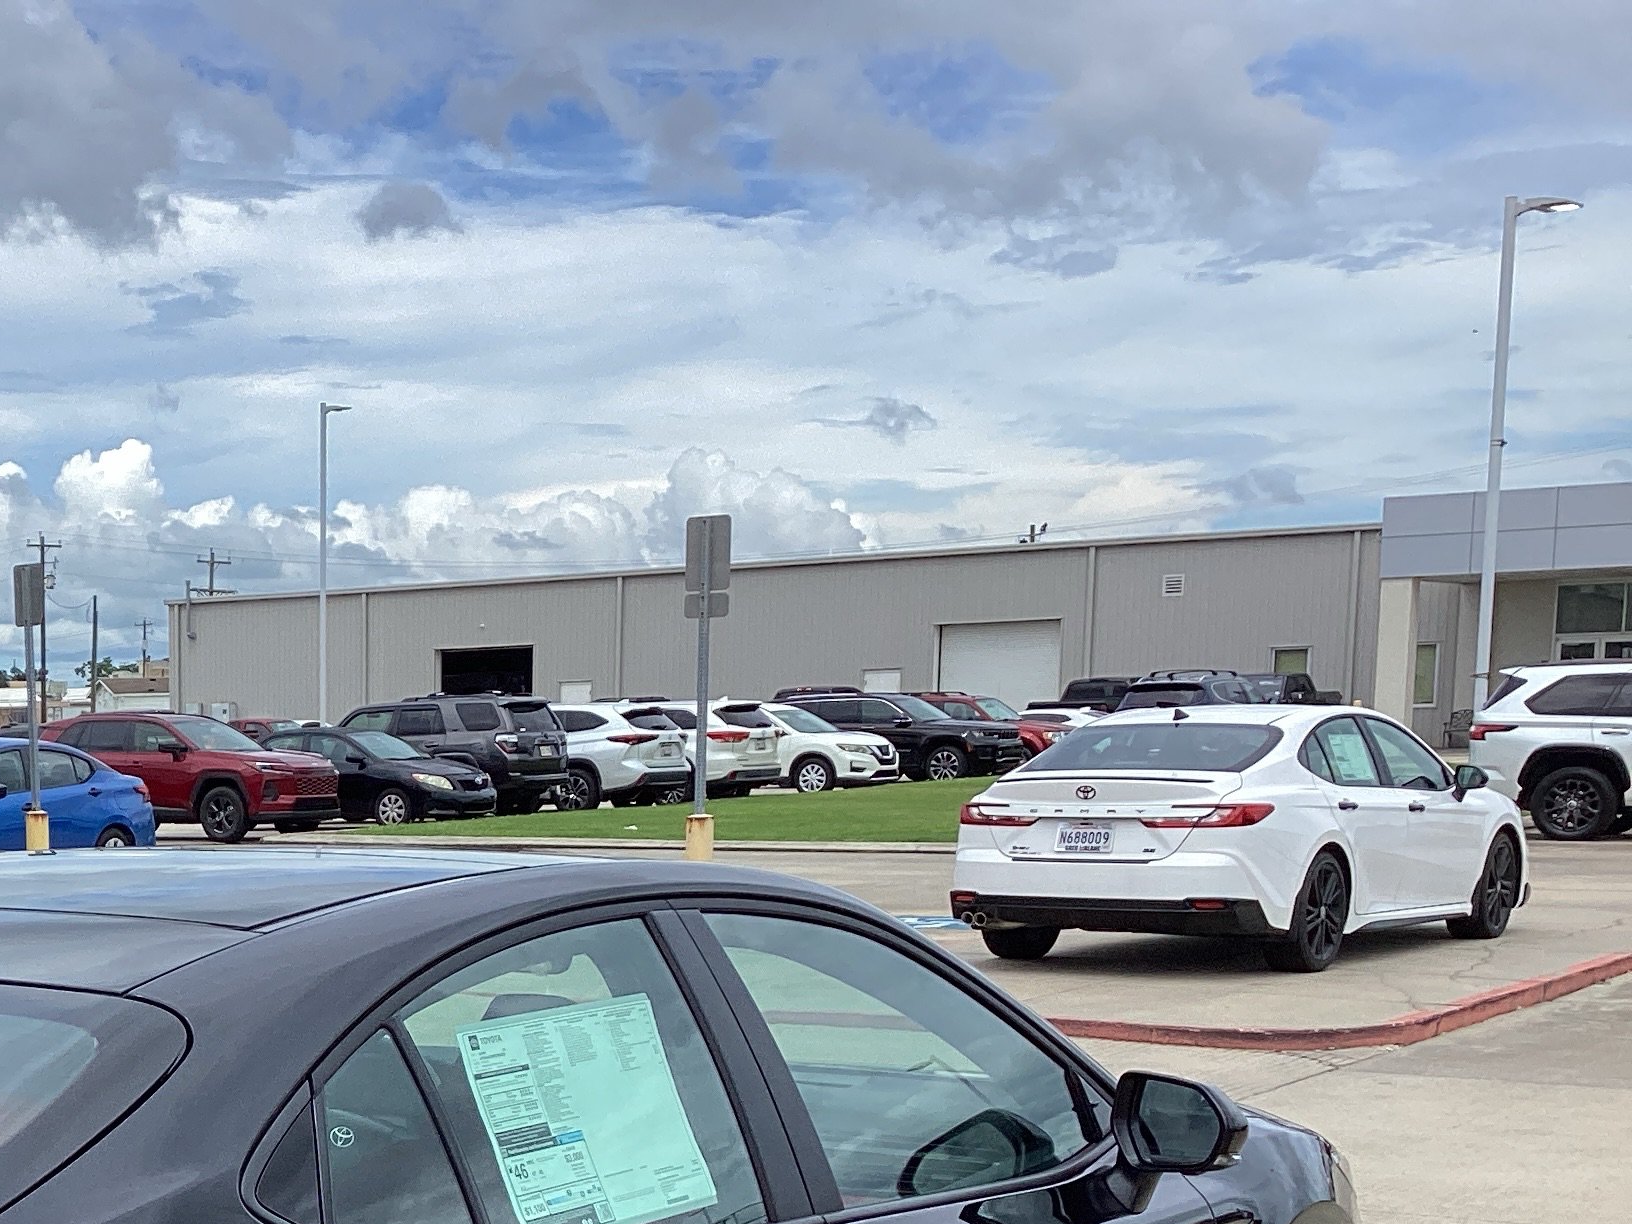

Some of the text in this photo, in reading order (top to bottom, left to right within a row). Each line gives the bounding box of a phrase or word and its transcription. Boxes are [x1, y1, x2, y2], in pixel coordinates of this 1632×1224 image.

[1060, 831, 1110, 845] N688009
[479, 1034, 503, 1045] TOYOTA
[514, 1163, 529, 1180] 46
